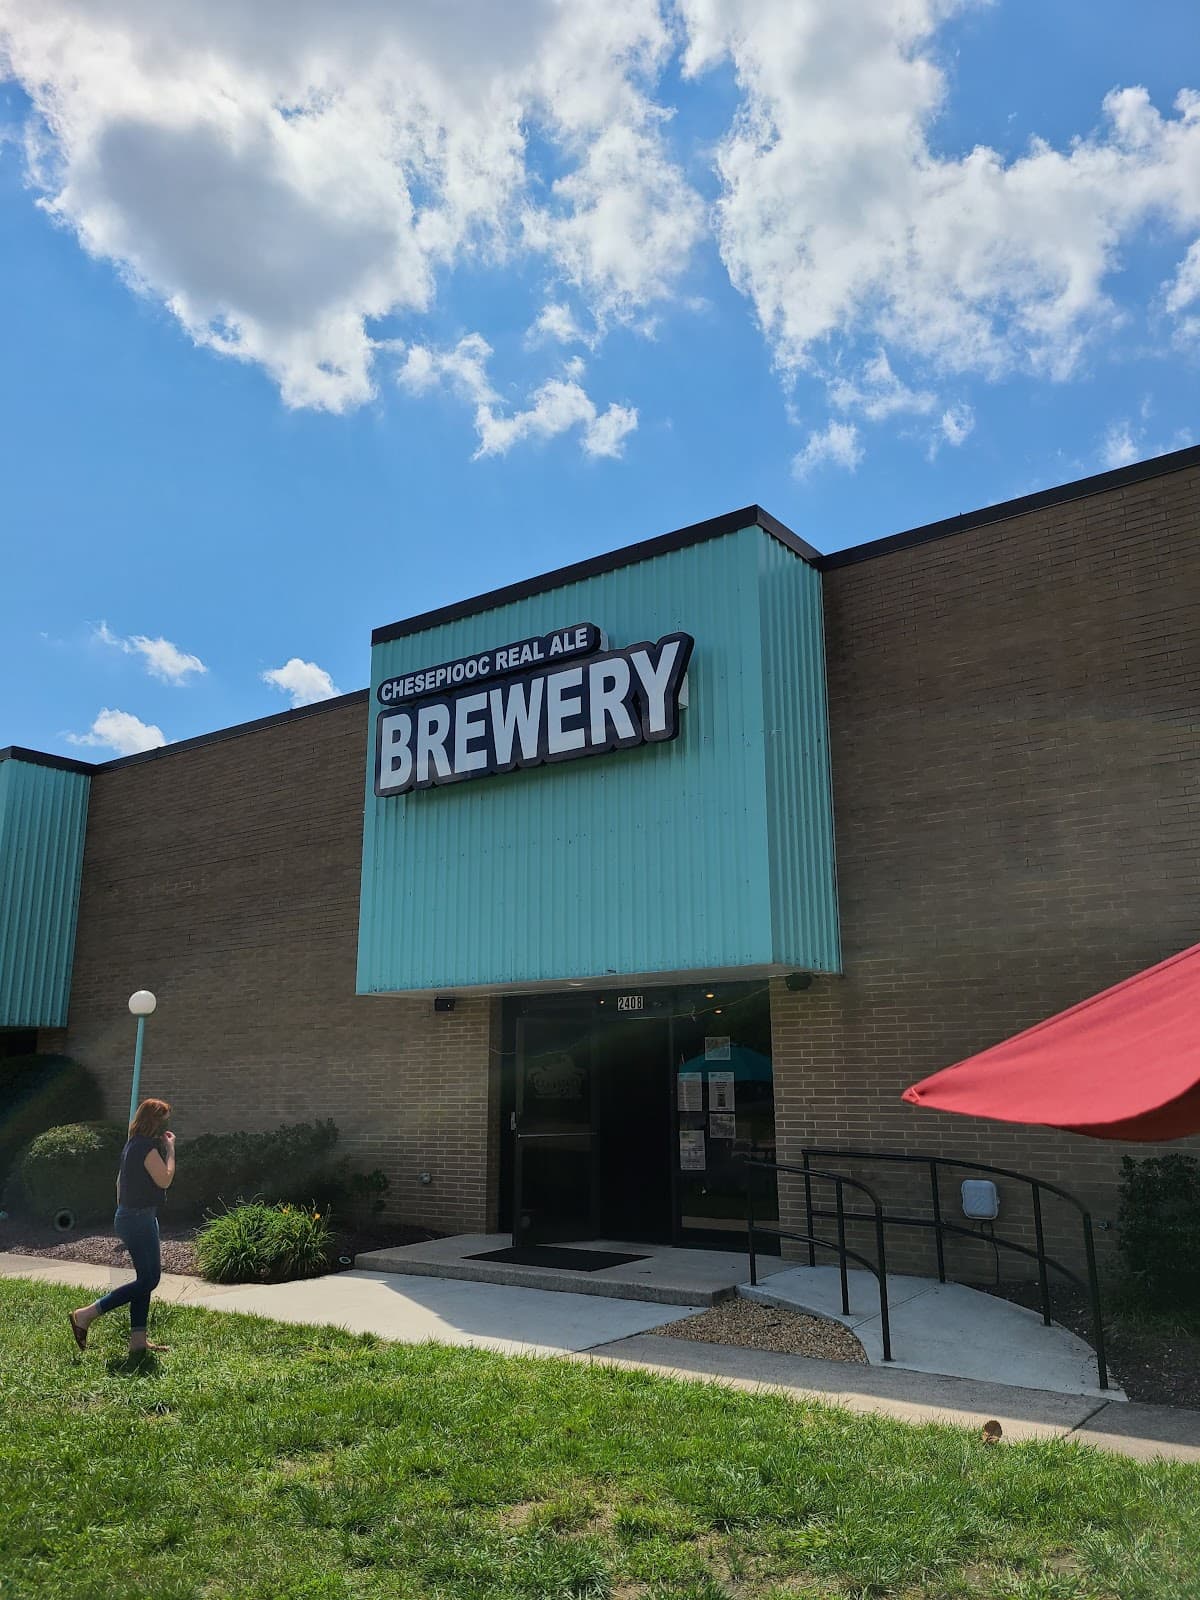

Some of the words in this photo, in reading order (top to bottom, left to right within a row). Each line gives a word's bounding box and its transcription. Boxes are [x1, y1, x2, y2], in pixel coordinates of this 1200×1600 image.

[381, 656, 490, 701] CHESEPIOOC
[496, 641, 544, 671] REAL
[549, 627, 588, 655] ALE
[379, 641, 680, 789] BREWERY
[618, 996, 642, 1010] 2408
